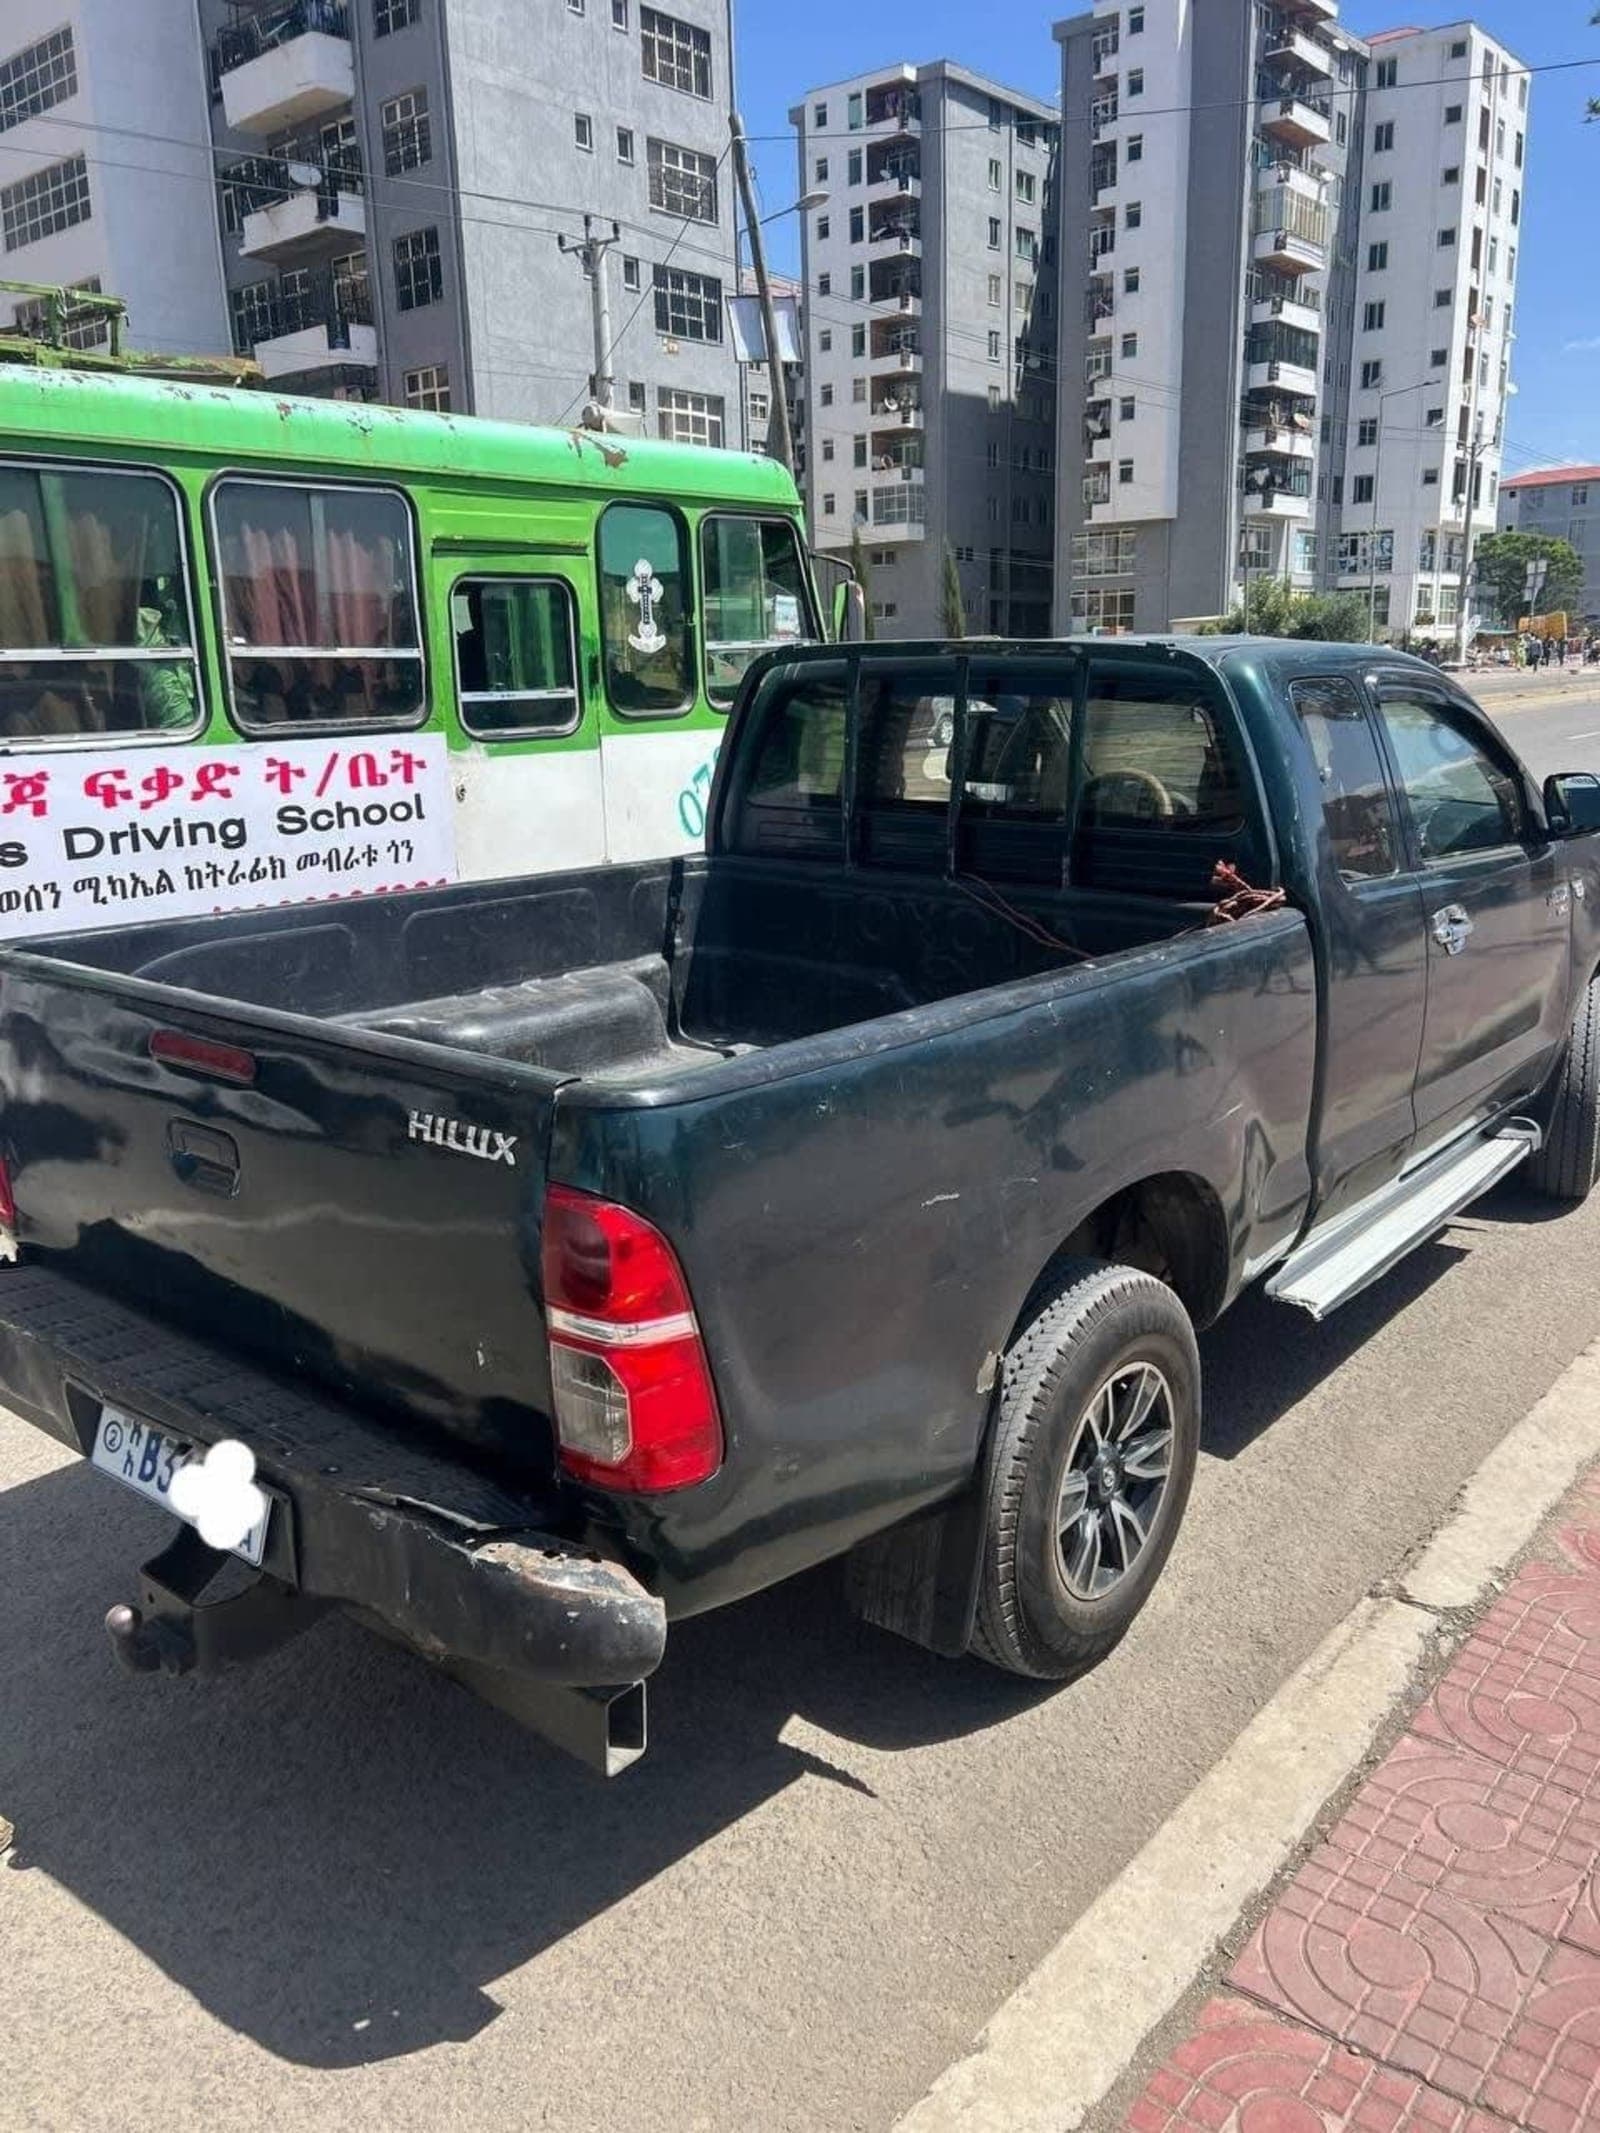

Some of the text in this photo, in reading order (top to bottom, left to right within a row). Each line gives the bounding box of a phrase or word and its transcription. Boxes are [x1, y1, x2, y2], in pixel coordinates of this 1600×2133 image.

[3, 749, 428, 816] ጃ ፍቃድ ት/ቤት
[63, 817, 247, 861] Driving
[277, 793, 426, 836] School
[408, 1110, 518, 1166] HILUX
